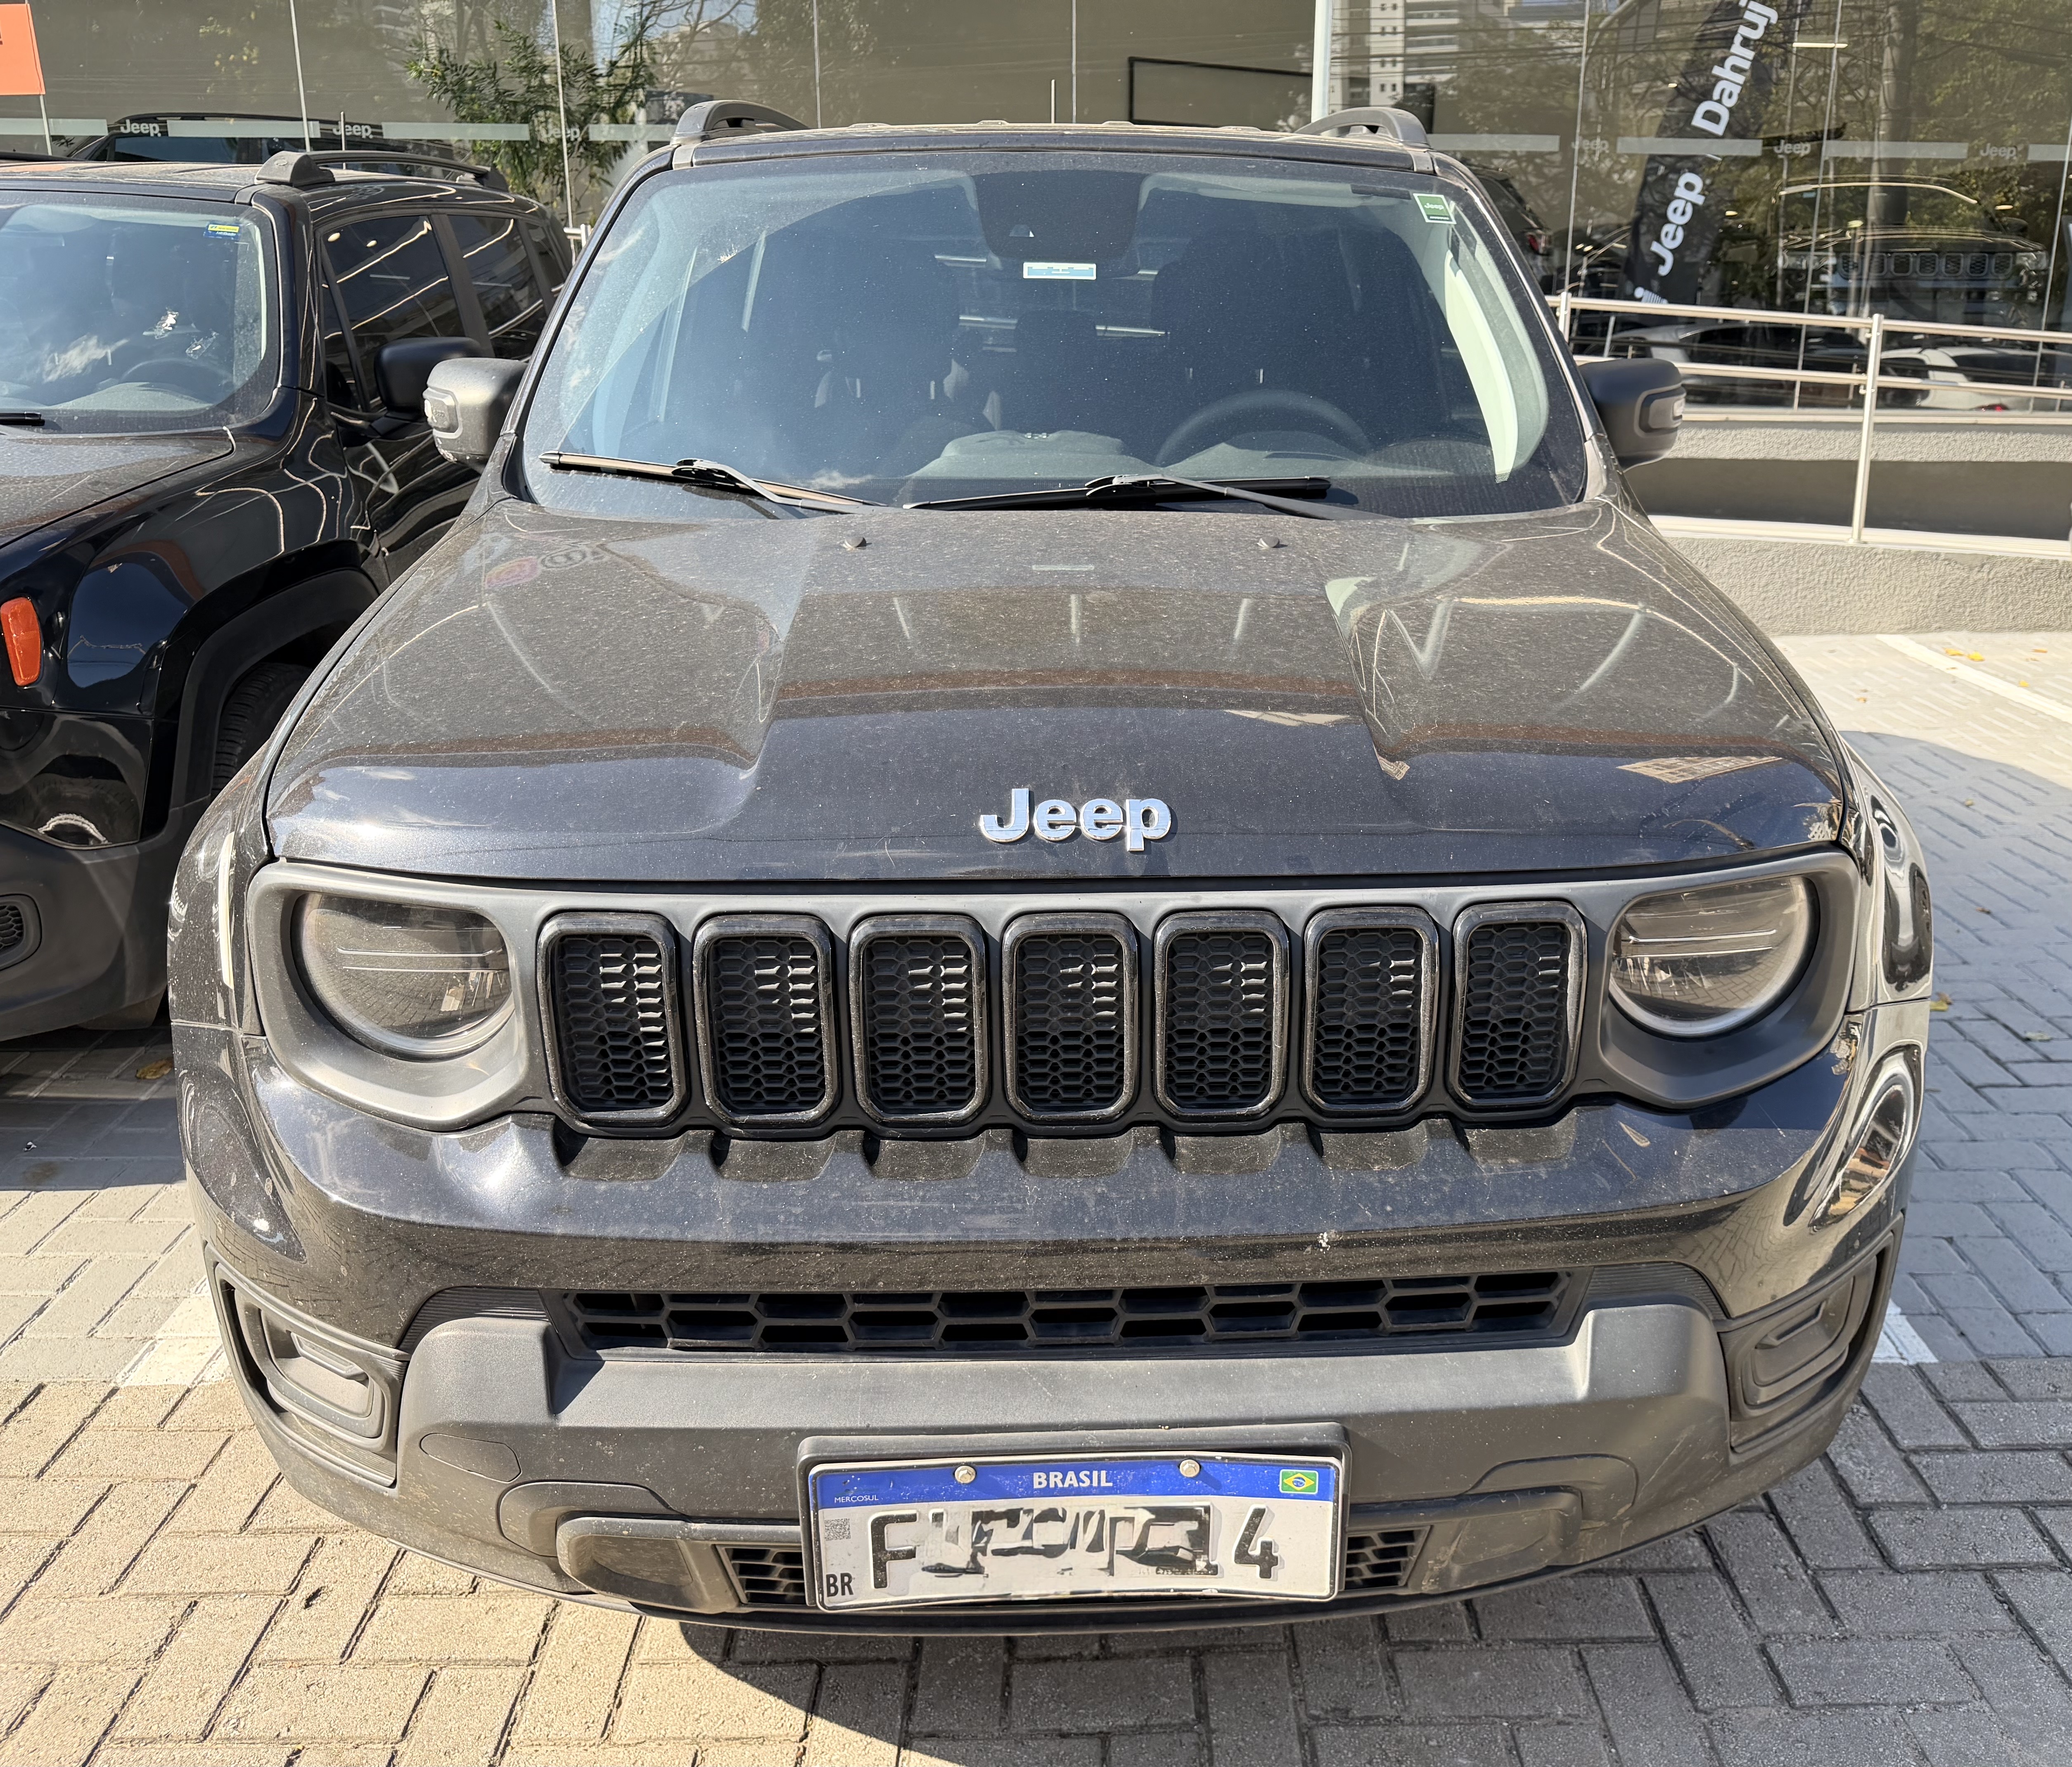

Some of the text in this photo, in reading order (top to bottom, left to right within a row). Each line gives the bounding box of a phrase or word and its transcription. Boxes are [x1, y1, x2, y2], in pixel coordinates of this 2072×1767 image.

[1650, 0, 1778, 276] Jeep Dahruj
[1773, 140, 1811, 157] Jeep
[980, 788, 1171, 851] Jeep
[1033, 1470, 1113, 1489] BRASIL
[834, 1494, 879, 1503] MERCOSUL
[826, 1572, 854, 1597] BR
